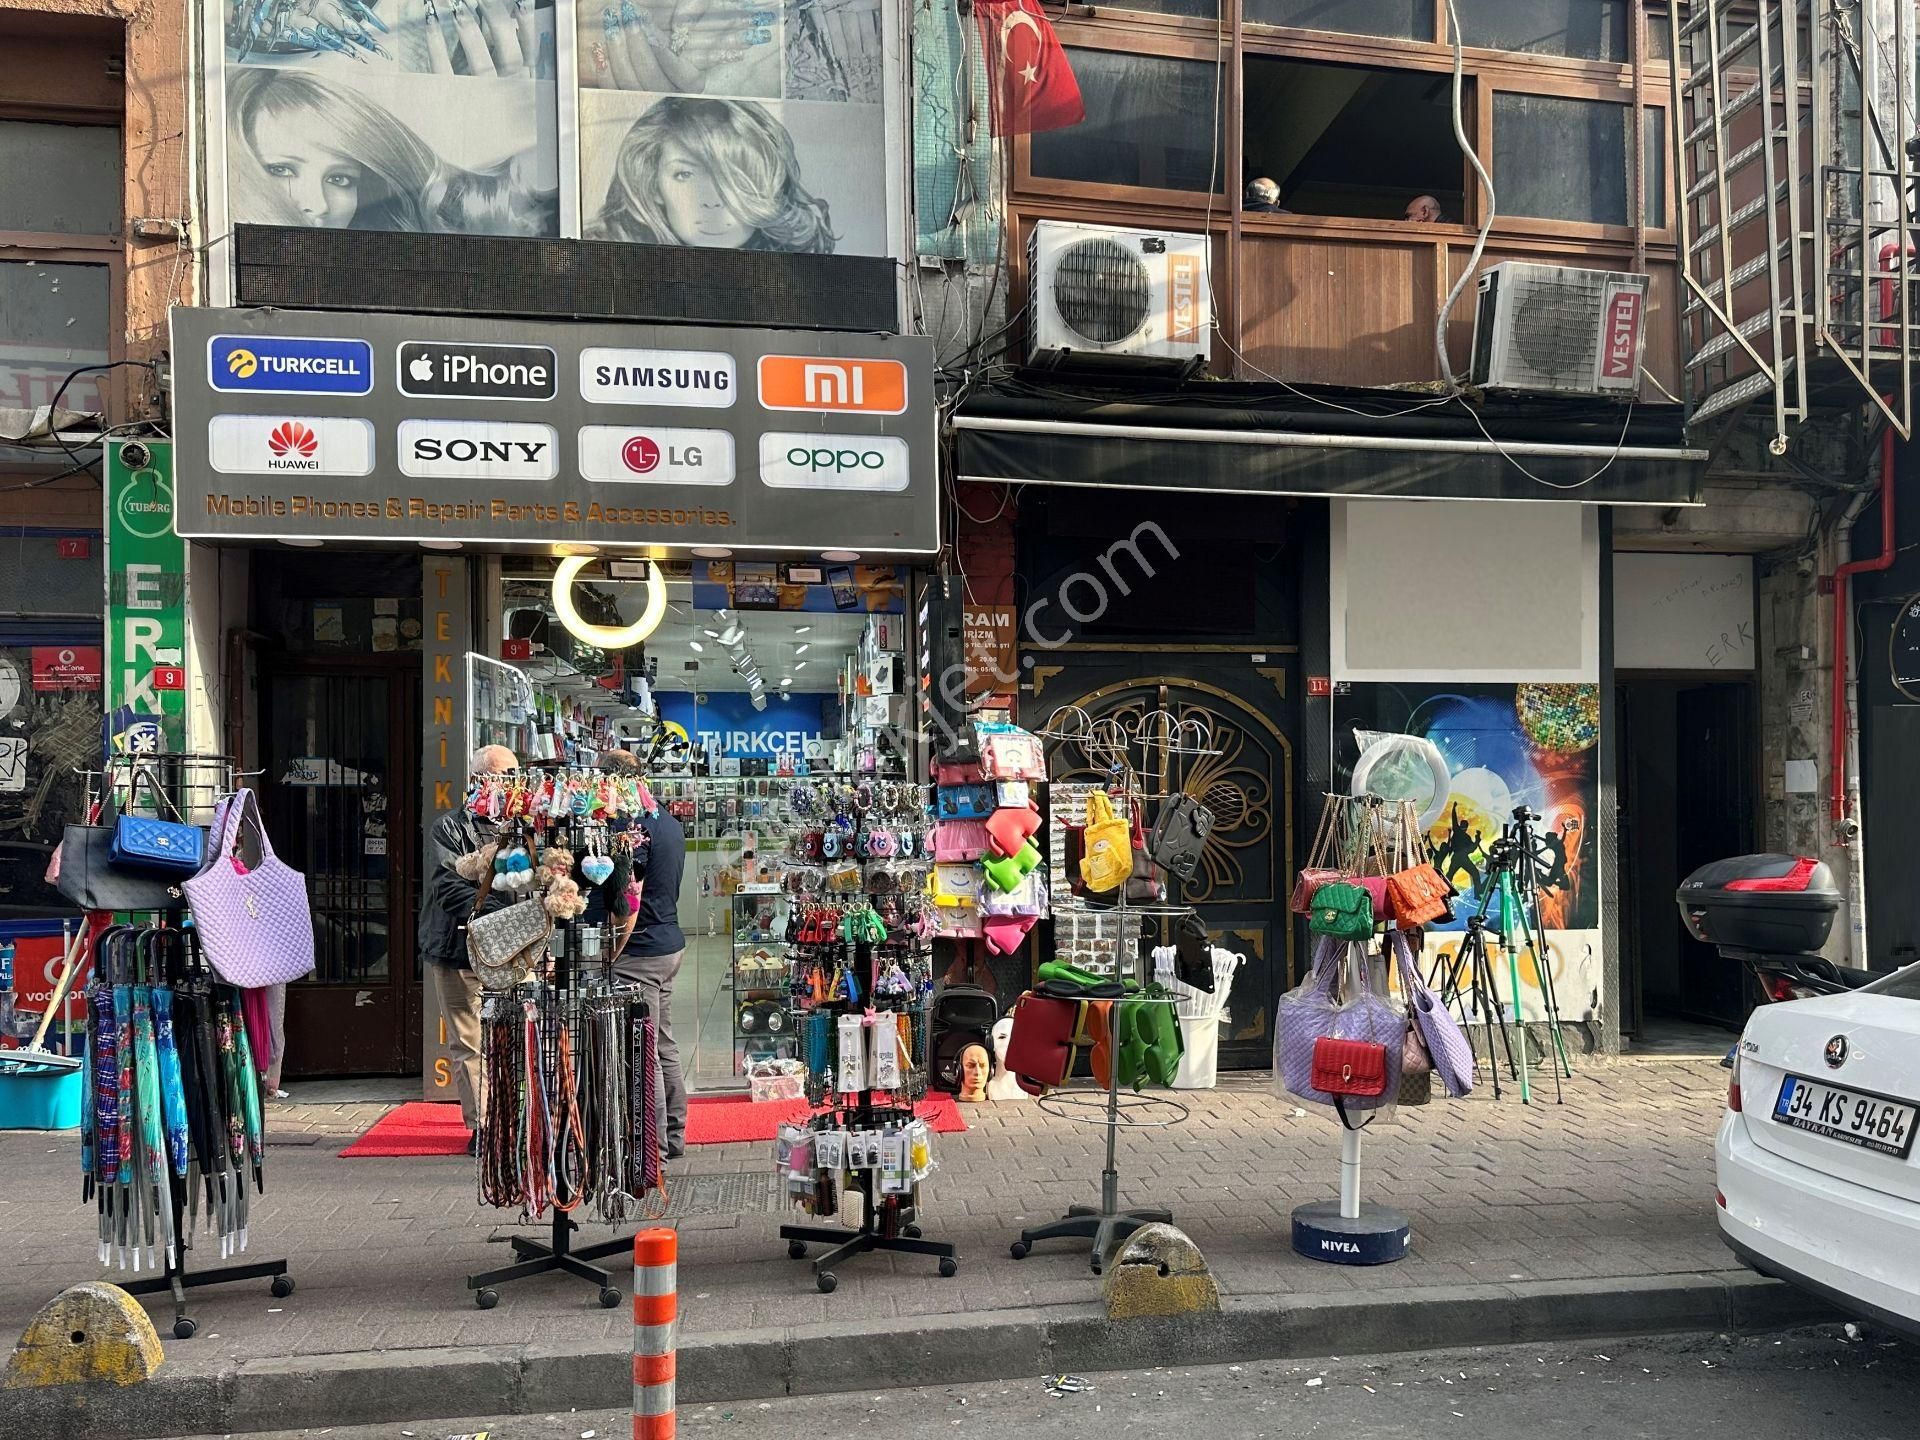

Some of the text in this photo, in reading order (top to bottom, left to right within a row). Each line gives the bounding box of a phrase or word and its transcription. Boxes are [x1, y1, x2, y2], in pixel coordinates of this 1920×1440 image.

[1610, 296, 1635, 375] VESTEL
[259, 356, 361, 376] TURKCELL
[442, 354, 547, 386] iPhone
[595, 365, 729, 391] SAMSUNG
[413, 438, 547, 463] SONY
[668, 446, 703, 467] LG
[786, 447, 884, 474] oppo
[268, 460, 319, 470] HUAWEI
[206, 494, 737, 527] Mobile Phones & Repair Parts & Accessories.
[1704, 621, 1754, 668] ERK
[165, 672, 175, 686] 9
[26, 990, 87, 1002] vodon
[1790, 1084, 1905, 1143] 34 KS 9464
[1321, 1239, 1360, 1253] NIVEA
